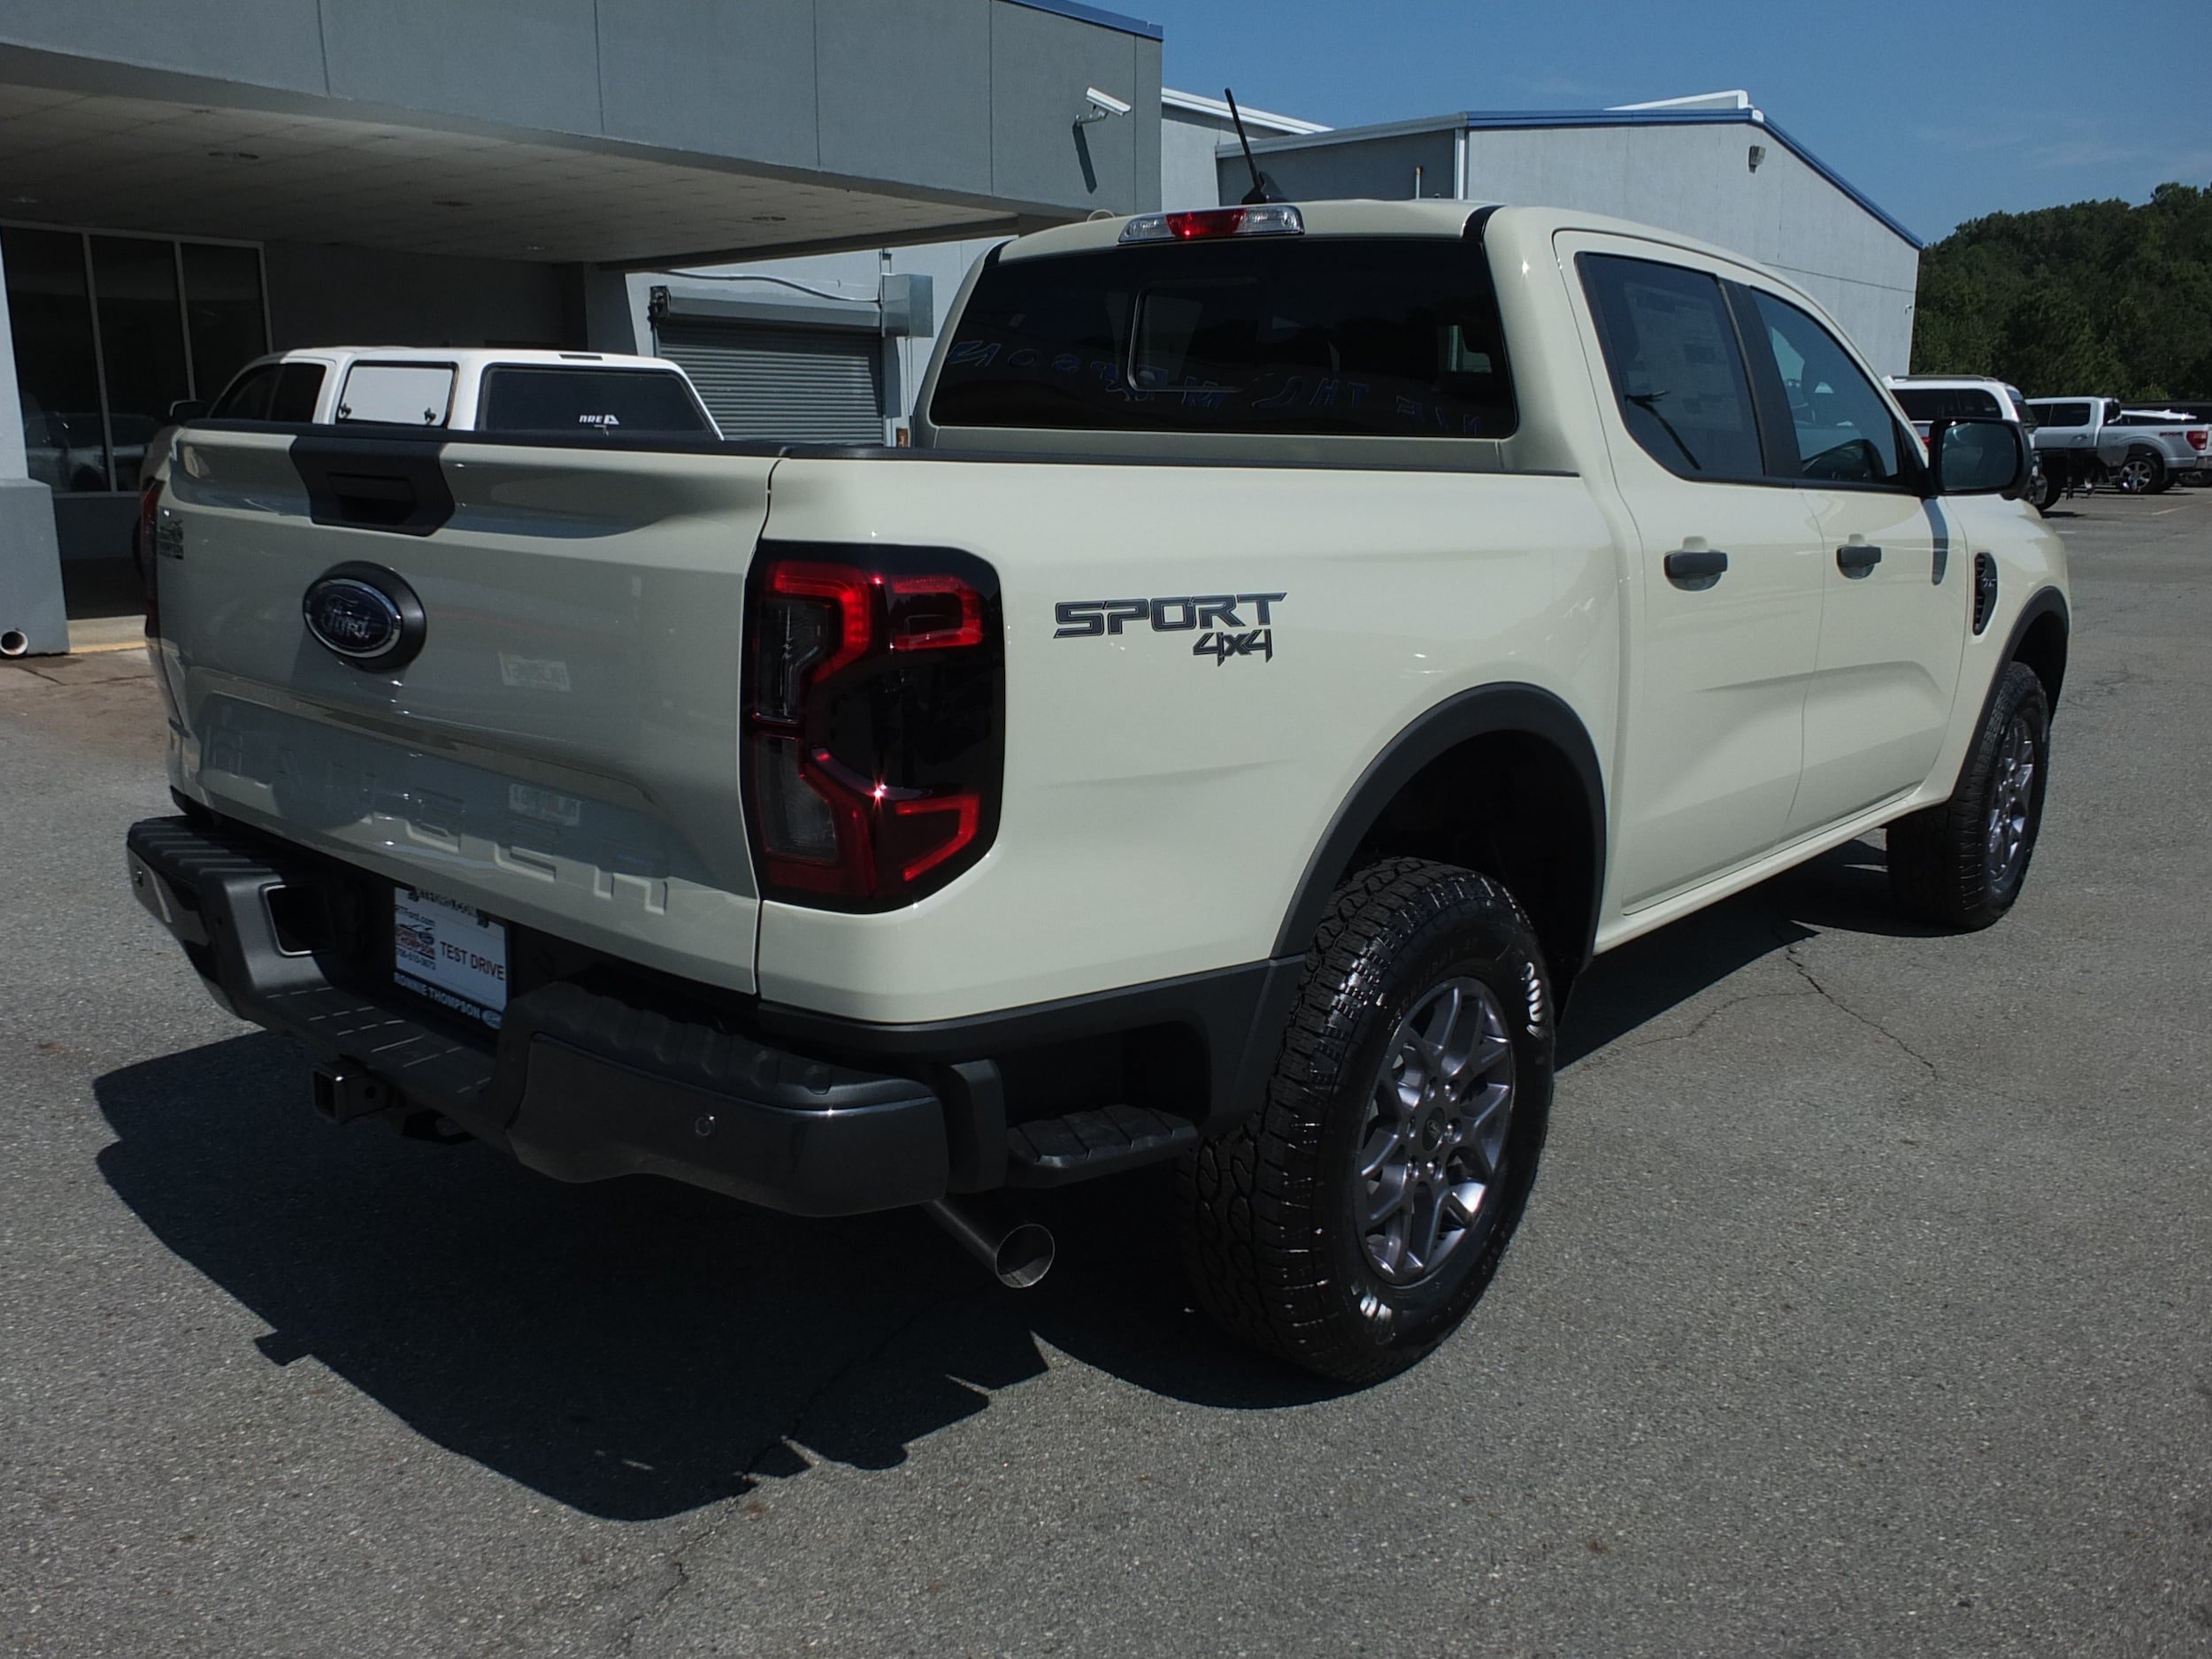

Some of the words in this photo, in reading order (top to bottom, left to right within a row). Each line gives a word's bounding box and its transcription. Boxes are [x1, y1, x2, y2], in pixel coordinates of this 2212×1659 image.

[1053, 592, 1287, 639] SPORT
[1193, 628, 1273, 667] 4x4
[440, 941, 468, 964] TEST
[471, 953, 505, 981] DRIVE
[428, 985, 481, 1020] THOMPSON
